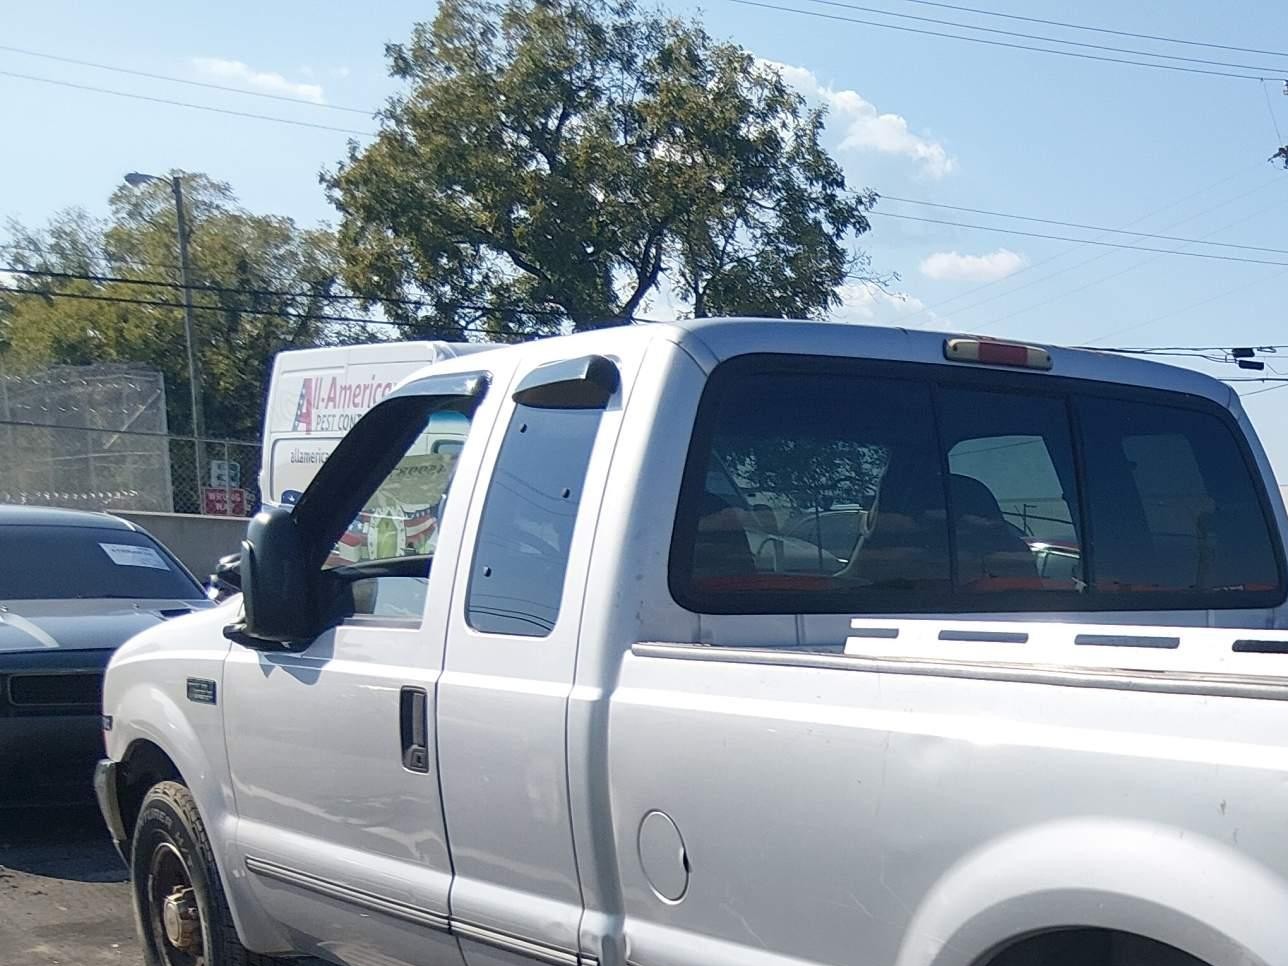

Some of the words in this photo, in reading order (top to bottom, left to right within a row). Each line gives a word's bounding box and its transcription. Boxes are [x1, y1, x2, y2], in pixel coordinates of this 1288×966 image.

[292, 373, 398, 435] All-America
[315, 413, 337, 431] PEST
[338, 413, 362, 431] CONT
[290, 447, 329, 464] allamerica
